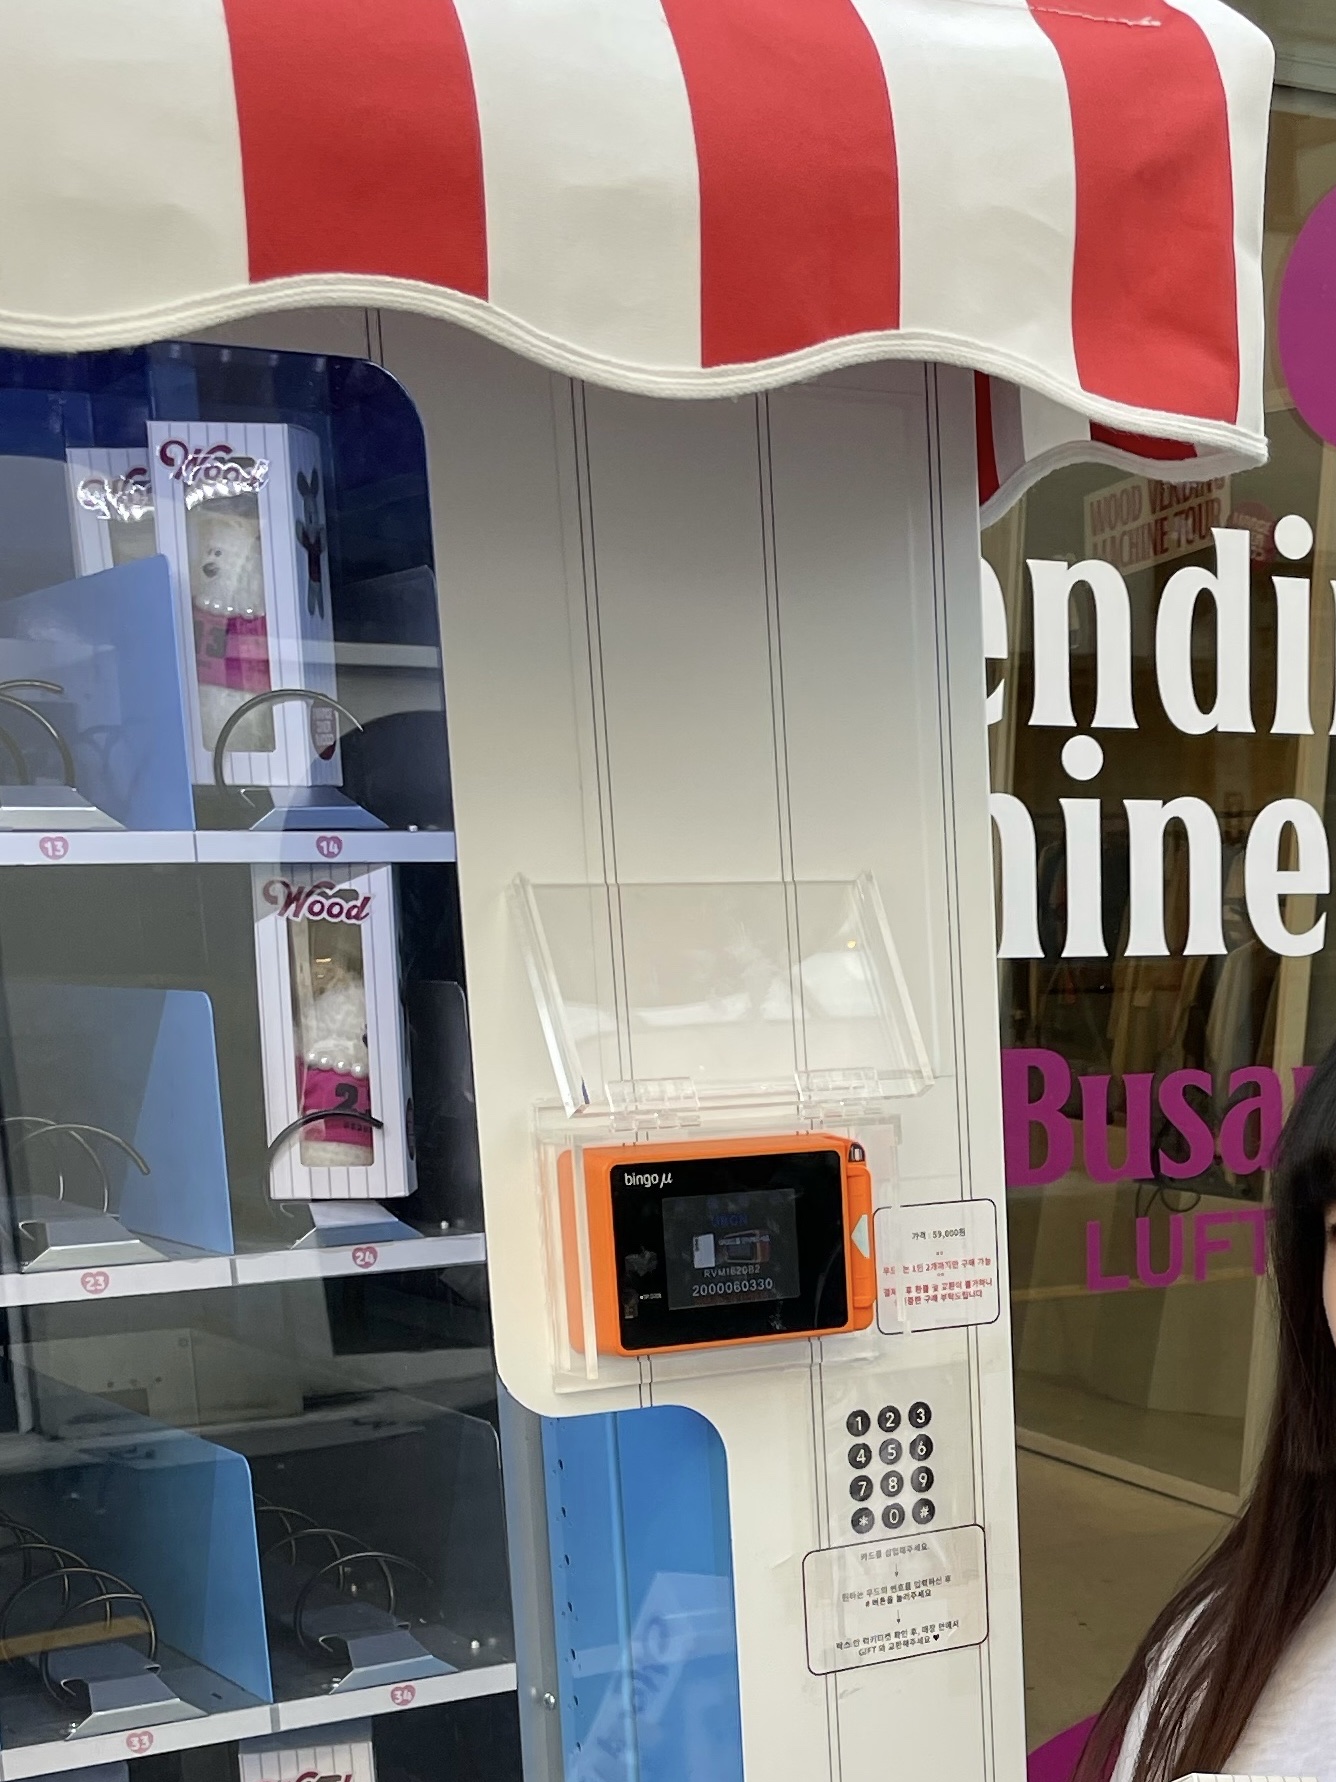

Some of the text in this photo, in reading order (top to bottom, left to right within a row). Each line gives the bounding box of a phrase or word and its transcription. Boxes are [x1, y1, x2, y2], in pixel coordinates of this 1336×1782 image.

[43, 842, 64, 857] 13
[318, 842, 339, 857] 14
[262, 879, 371, 921] Wood
[1000, 1047, 1317, 1187] Busa
[354, 1250, 375, 1266] 24
[1086, 1208, 1278, 1292] LUFT
[84, 1275, 106, 1291] 23
[692, 1278, 773, 1297] 2000060330
[855, 1408, 926, 1431] 1 2 3
[856, 1440, 927, 1464] 4 5 6
[857, 1472, 928, 1497] 7 8 9
[888, 1508, 900, 1524] 0
